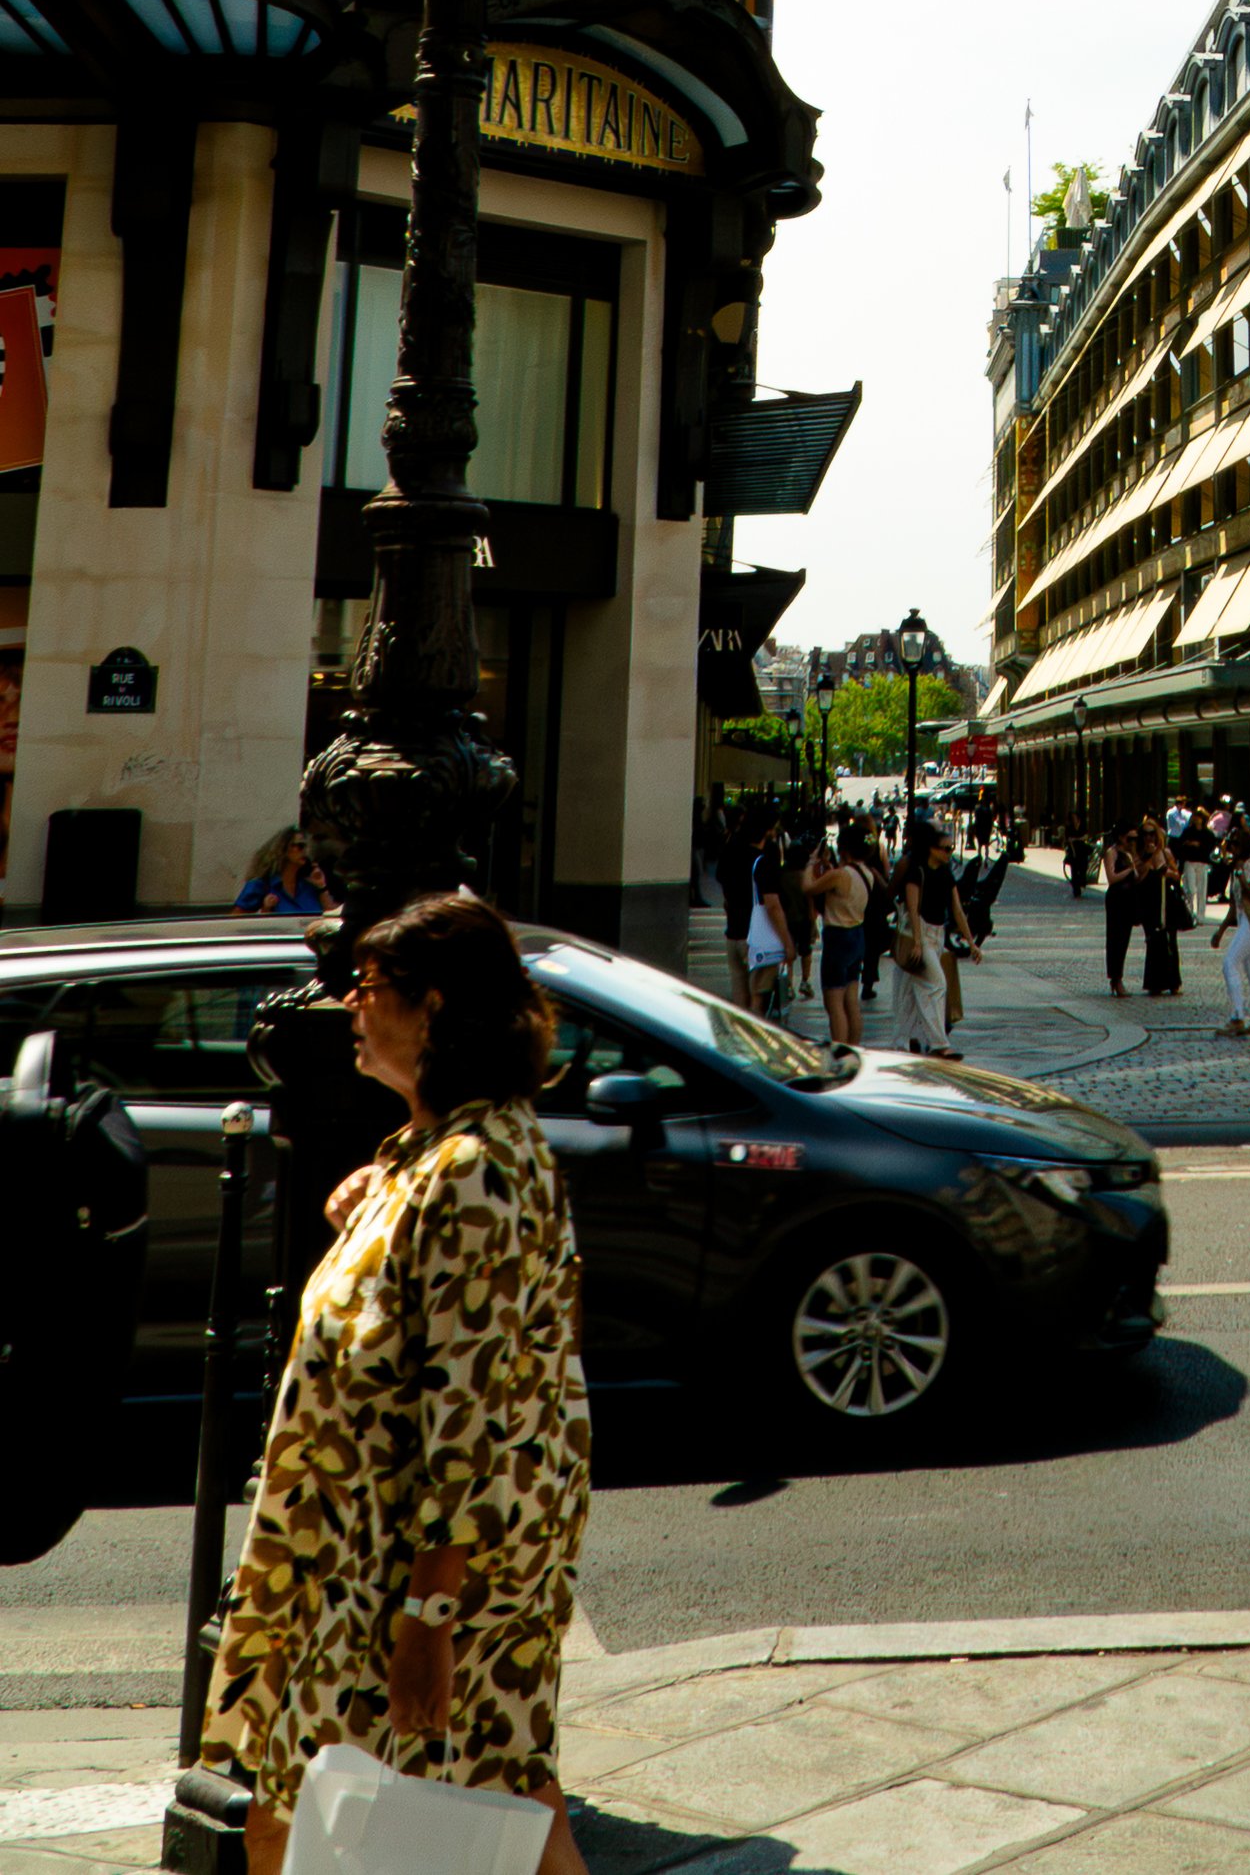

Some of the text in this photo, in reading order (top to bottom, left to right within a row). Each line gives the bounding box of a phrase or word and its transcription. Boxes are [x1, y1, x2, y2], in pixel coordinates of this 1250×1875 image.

[484, 55, 689, 163] ARITAINE
[111, 672, 136, 685] RUE
[102, 694, 142, 707] RIVOLI
